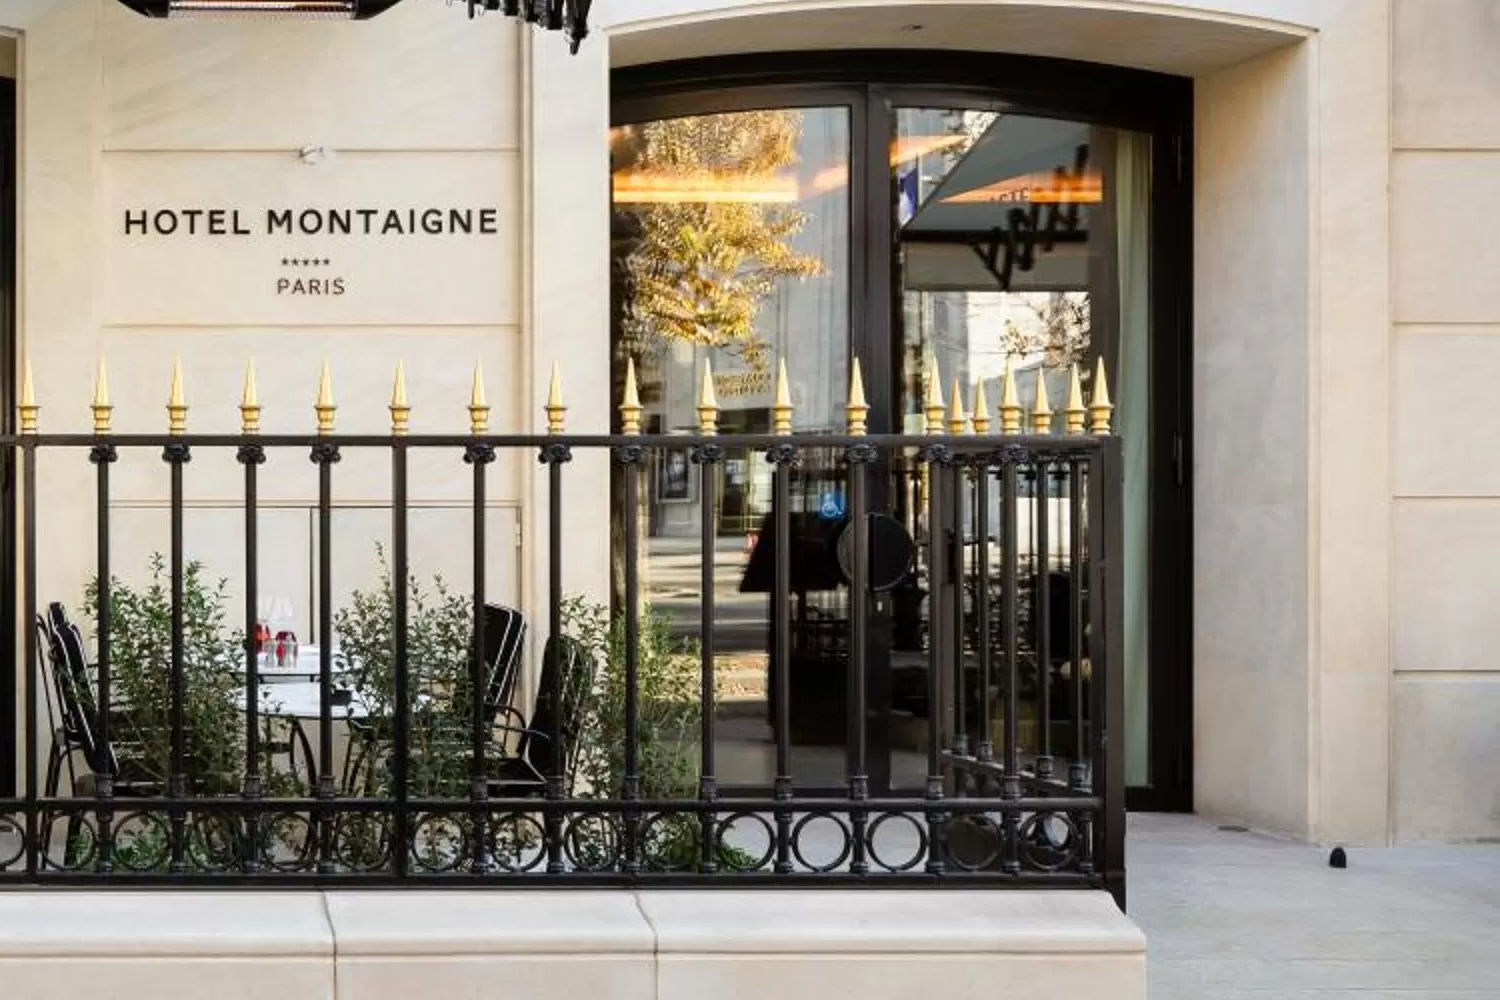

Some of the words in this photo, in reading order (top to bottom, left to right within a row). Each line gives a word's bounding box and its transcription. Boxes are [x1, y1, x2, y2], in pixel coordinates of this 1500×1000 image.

[125, 209, 251, 235] HOTEL
[267, 208, 497, 235] MONTAIGNE
[276, 278, 346, 296] PARIS
